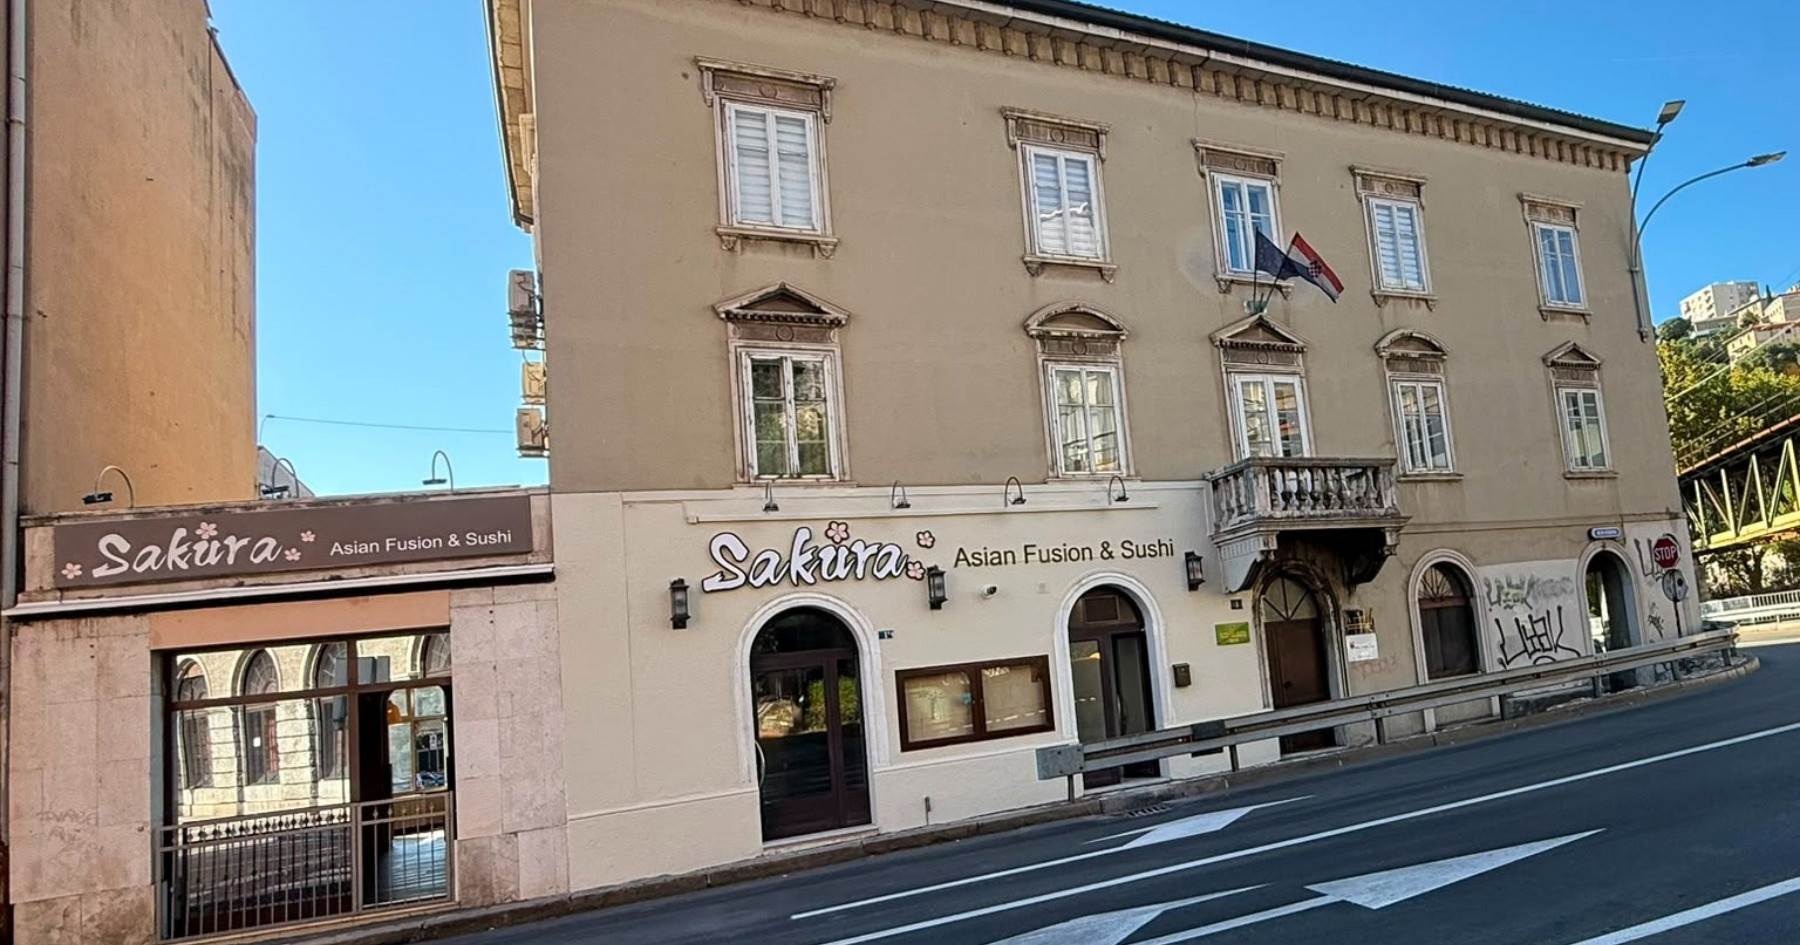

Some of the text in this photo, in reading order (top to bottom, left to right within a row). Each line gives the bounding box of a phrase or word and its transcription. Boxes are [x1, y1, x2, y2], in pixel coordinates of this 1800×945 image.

[92, 526, 282, 577] Sakura
[330, 530, 512, 556] Asian Fusion & Sushi
[954, 538, 1174, 568] Asian Fusion & Sushi
[1654, 546, 1677, 561] STOP
[702, 526, 909, 593] Sakura
